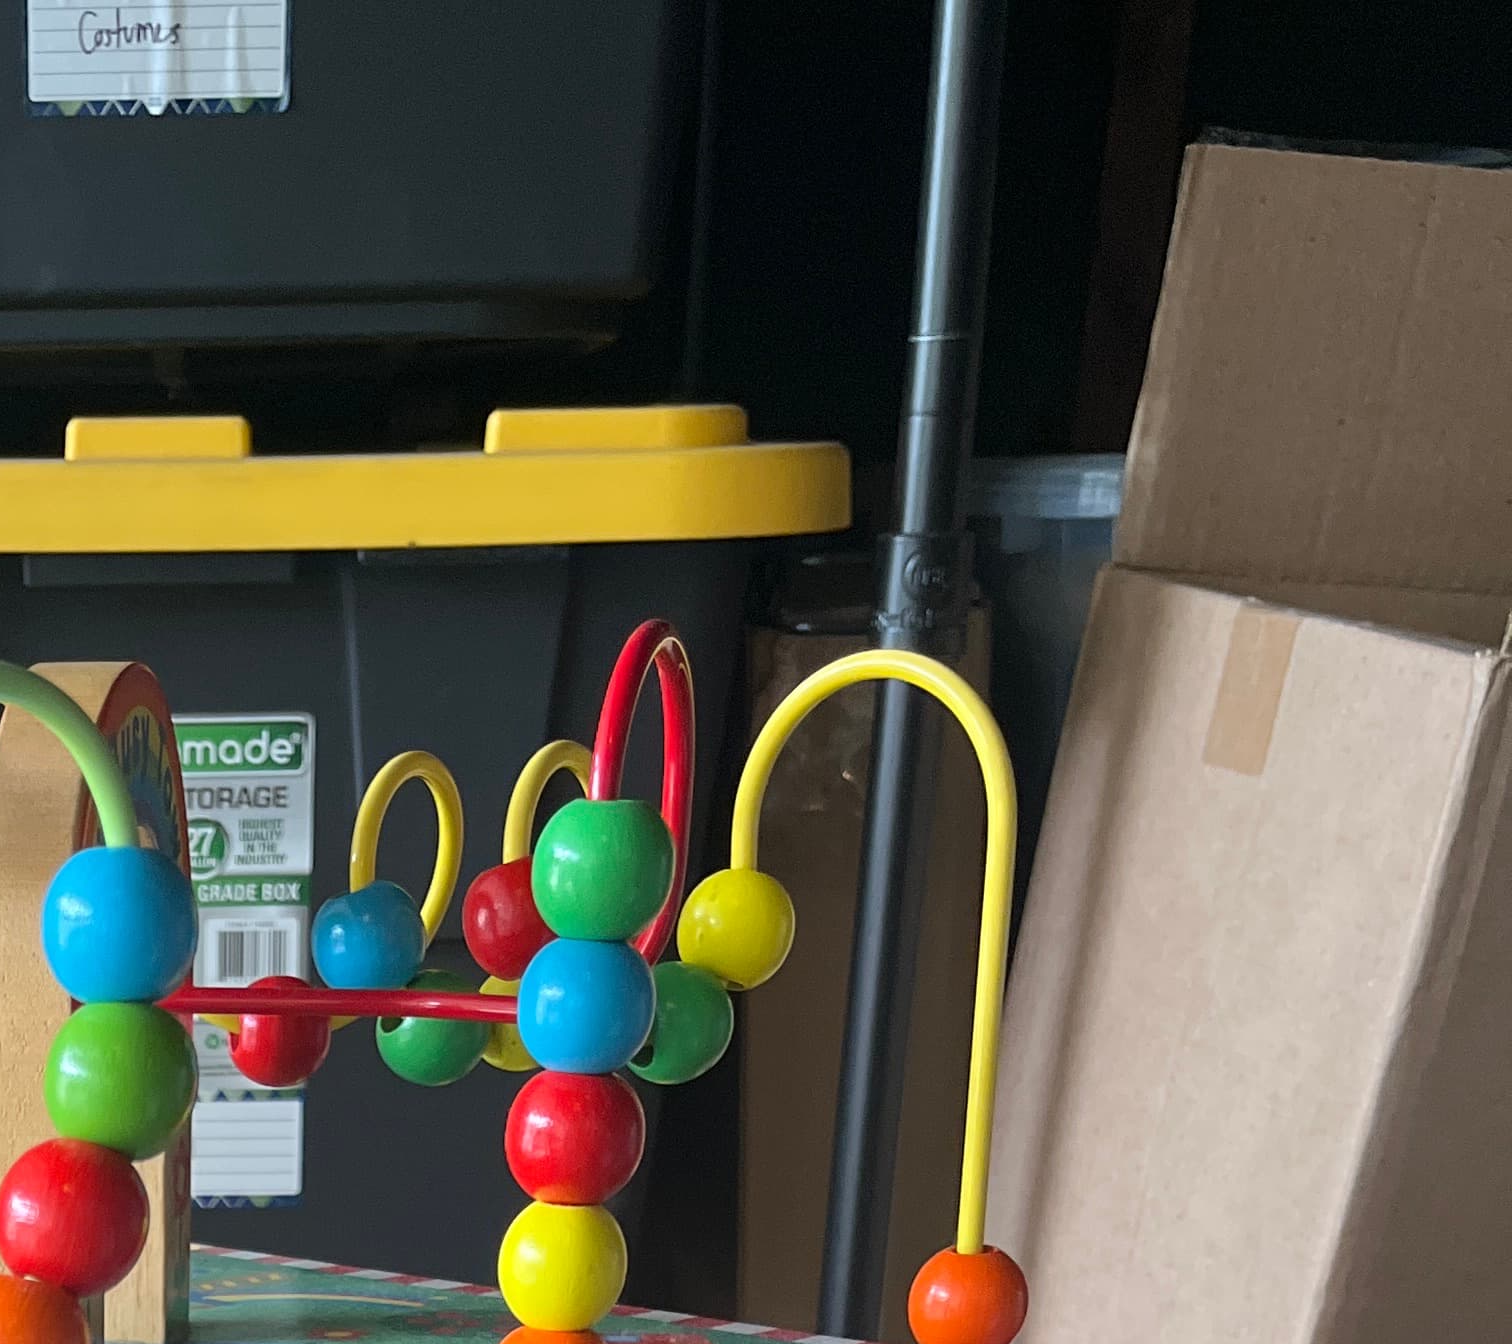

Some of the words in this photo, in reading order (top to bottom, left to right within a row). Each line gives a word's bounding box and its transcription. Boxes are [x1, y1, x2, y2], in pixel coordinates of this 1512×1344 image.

[78, 7, 181, 55] Costumes
[184, 785, 290, 809] TORAGE
[239, 818, 284, 830] HIGHEST
[239, 830, 284, 842] QUALITY
[234, 853, 288, 866] INDUSTRY
[197, 883, 257, 902] GRADE
[261, 882, 302, 901] BOX
